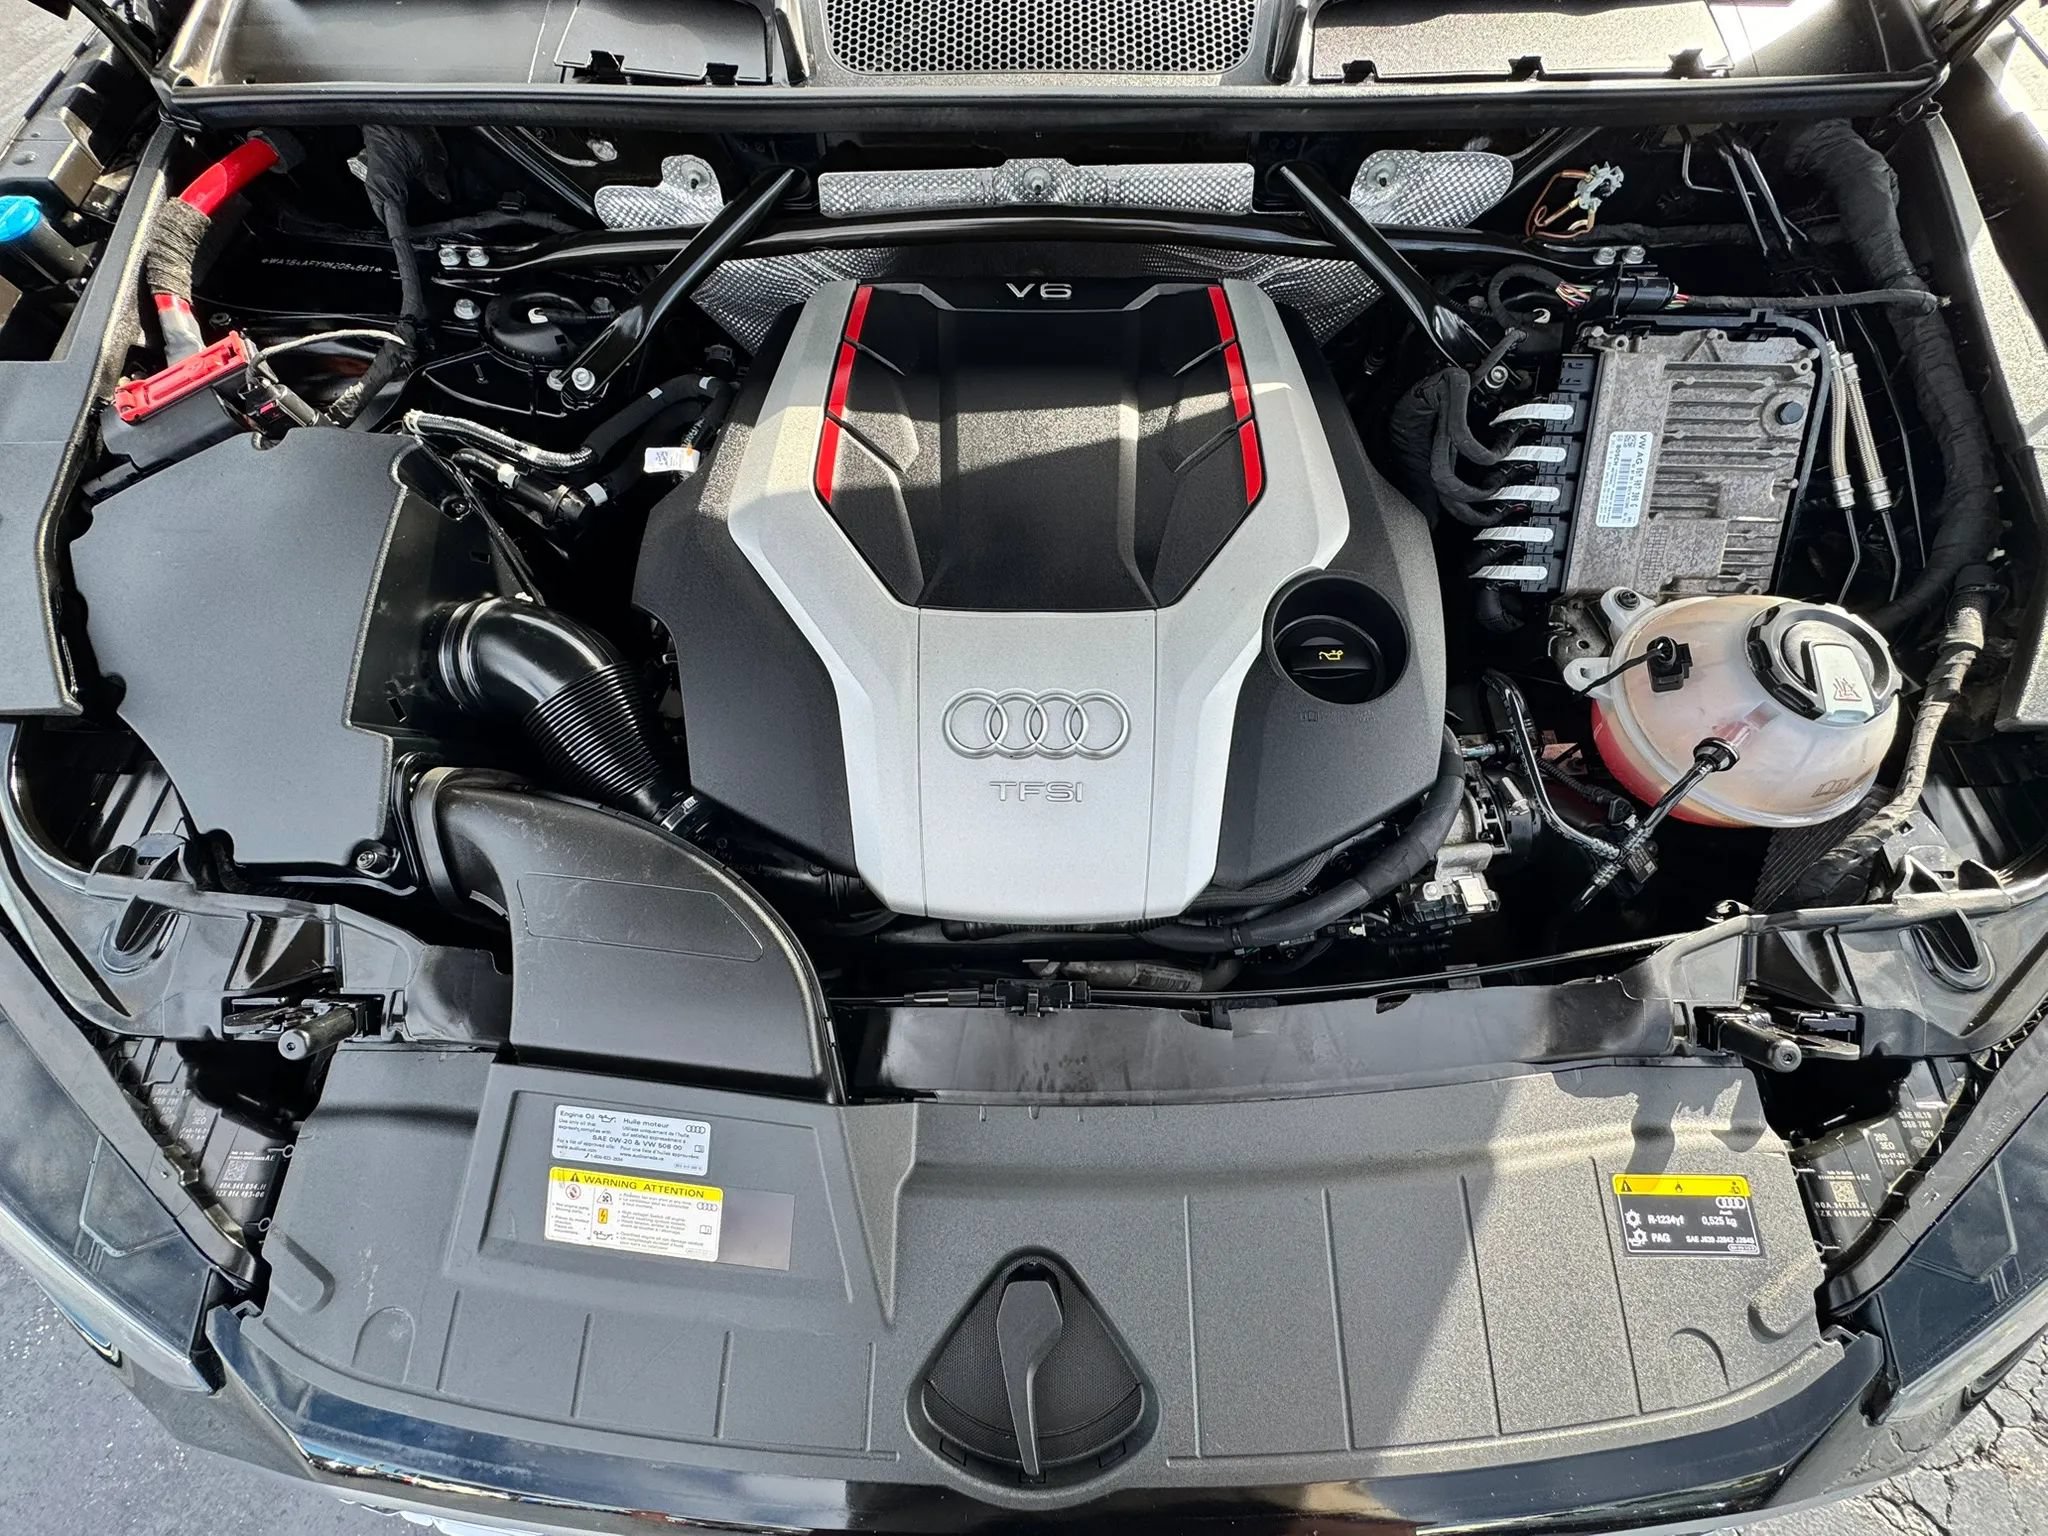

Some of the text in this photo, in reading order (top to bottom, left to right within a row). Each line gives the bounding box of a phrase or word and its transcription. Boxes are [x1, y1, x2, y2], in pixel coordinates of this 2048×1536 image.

[1005, 282, 1072, 298] V6
[1638, 434, 1647, 449] VW
[1635, 451, 1644, 465] AG
[989, 780, 1084, 802] TFSI
[560, 1110, 583, 1118] Engine
[623, 1117, 669, 1128] Huile moteur
[592, 1134, 607, 1142] SAE
[608, 1136, 633, 1144] 0W-20
[584, 1175, 705, 1198] WARNING ATTENTION
[1647, 1214, 1738, 1228] R-1234yf 0,525 kg
[1651, 1232, 1671, 1243] PAG
